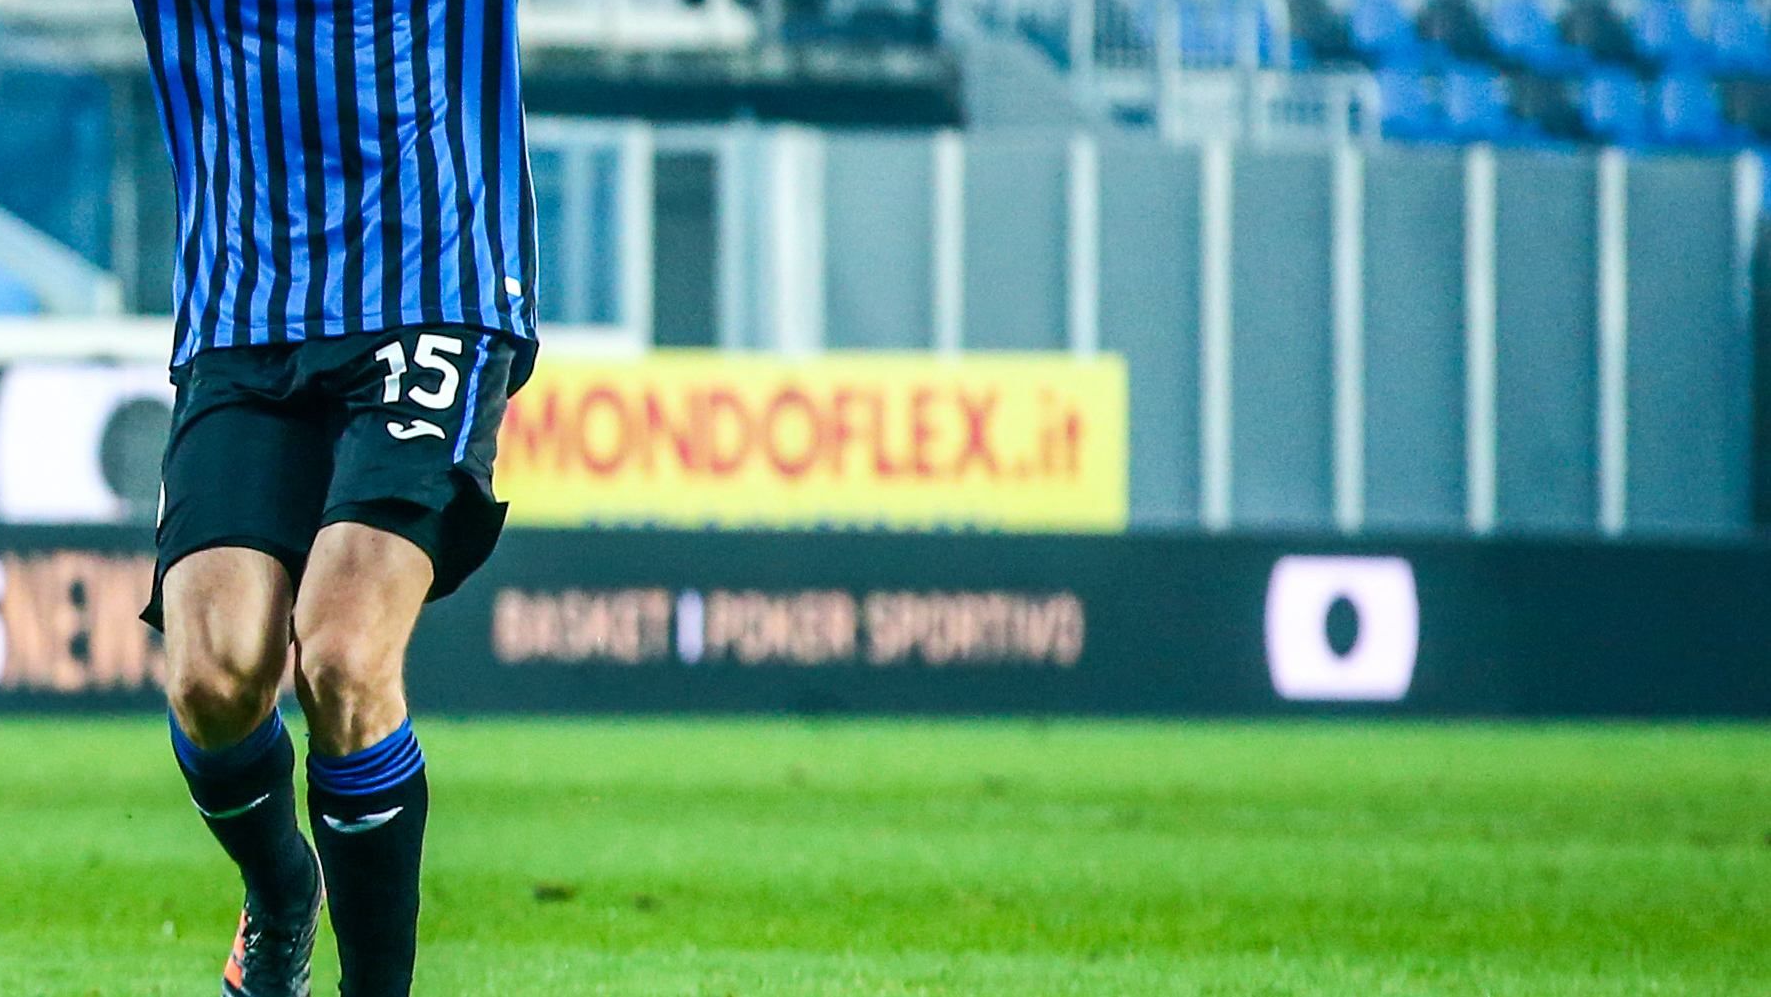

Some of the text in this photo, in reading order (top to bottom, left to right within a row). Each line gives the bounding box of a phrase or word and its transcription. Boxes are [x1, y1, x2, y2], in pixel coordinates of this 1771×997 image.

[375, 333, 463, 410] 15
[494, 589, 1085, 666] BASKET POKER SPORTIVO
